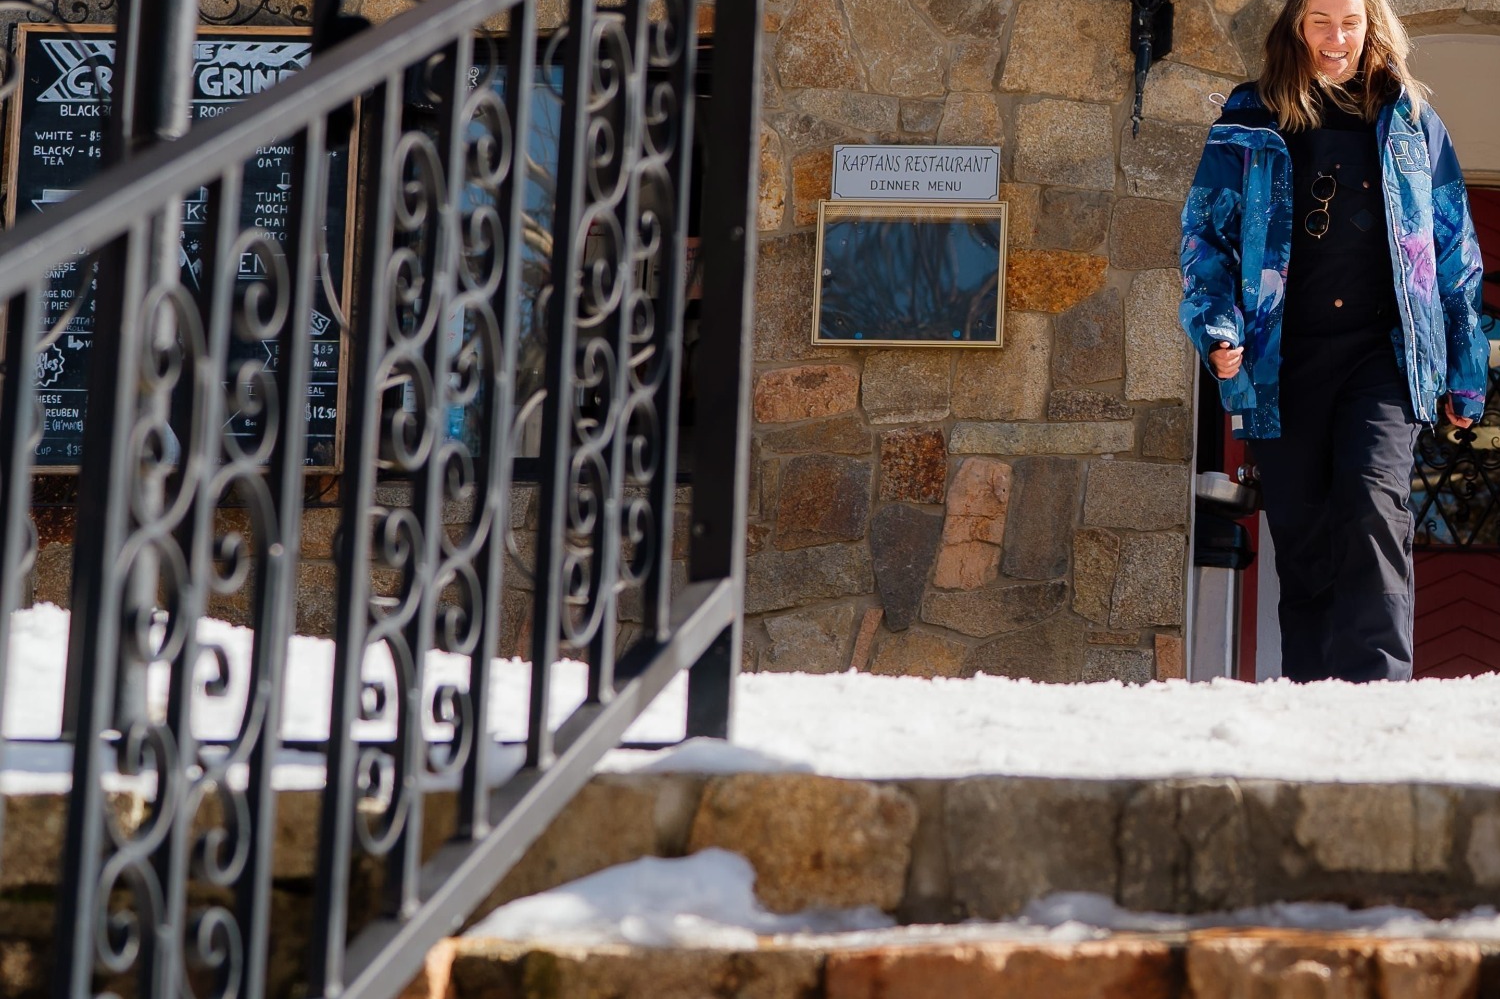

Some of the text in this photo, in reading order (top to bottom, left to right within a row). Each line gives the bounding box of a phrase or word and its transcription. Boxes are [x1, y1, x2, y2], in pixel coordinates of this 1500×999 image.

[200, 67, 298, 97] GRIN
[35, 131, 73, 141] WHITE
[42, 156, 64, 165] TEA
[257, 158, 282, 168] OAT
[842, 154, 993, 173] KAPTANS RESTAURANT
[870, 180, 962, 192] DINNER MENU
[45, 408, 79, 418] REUBEN
